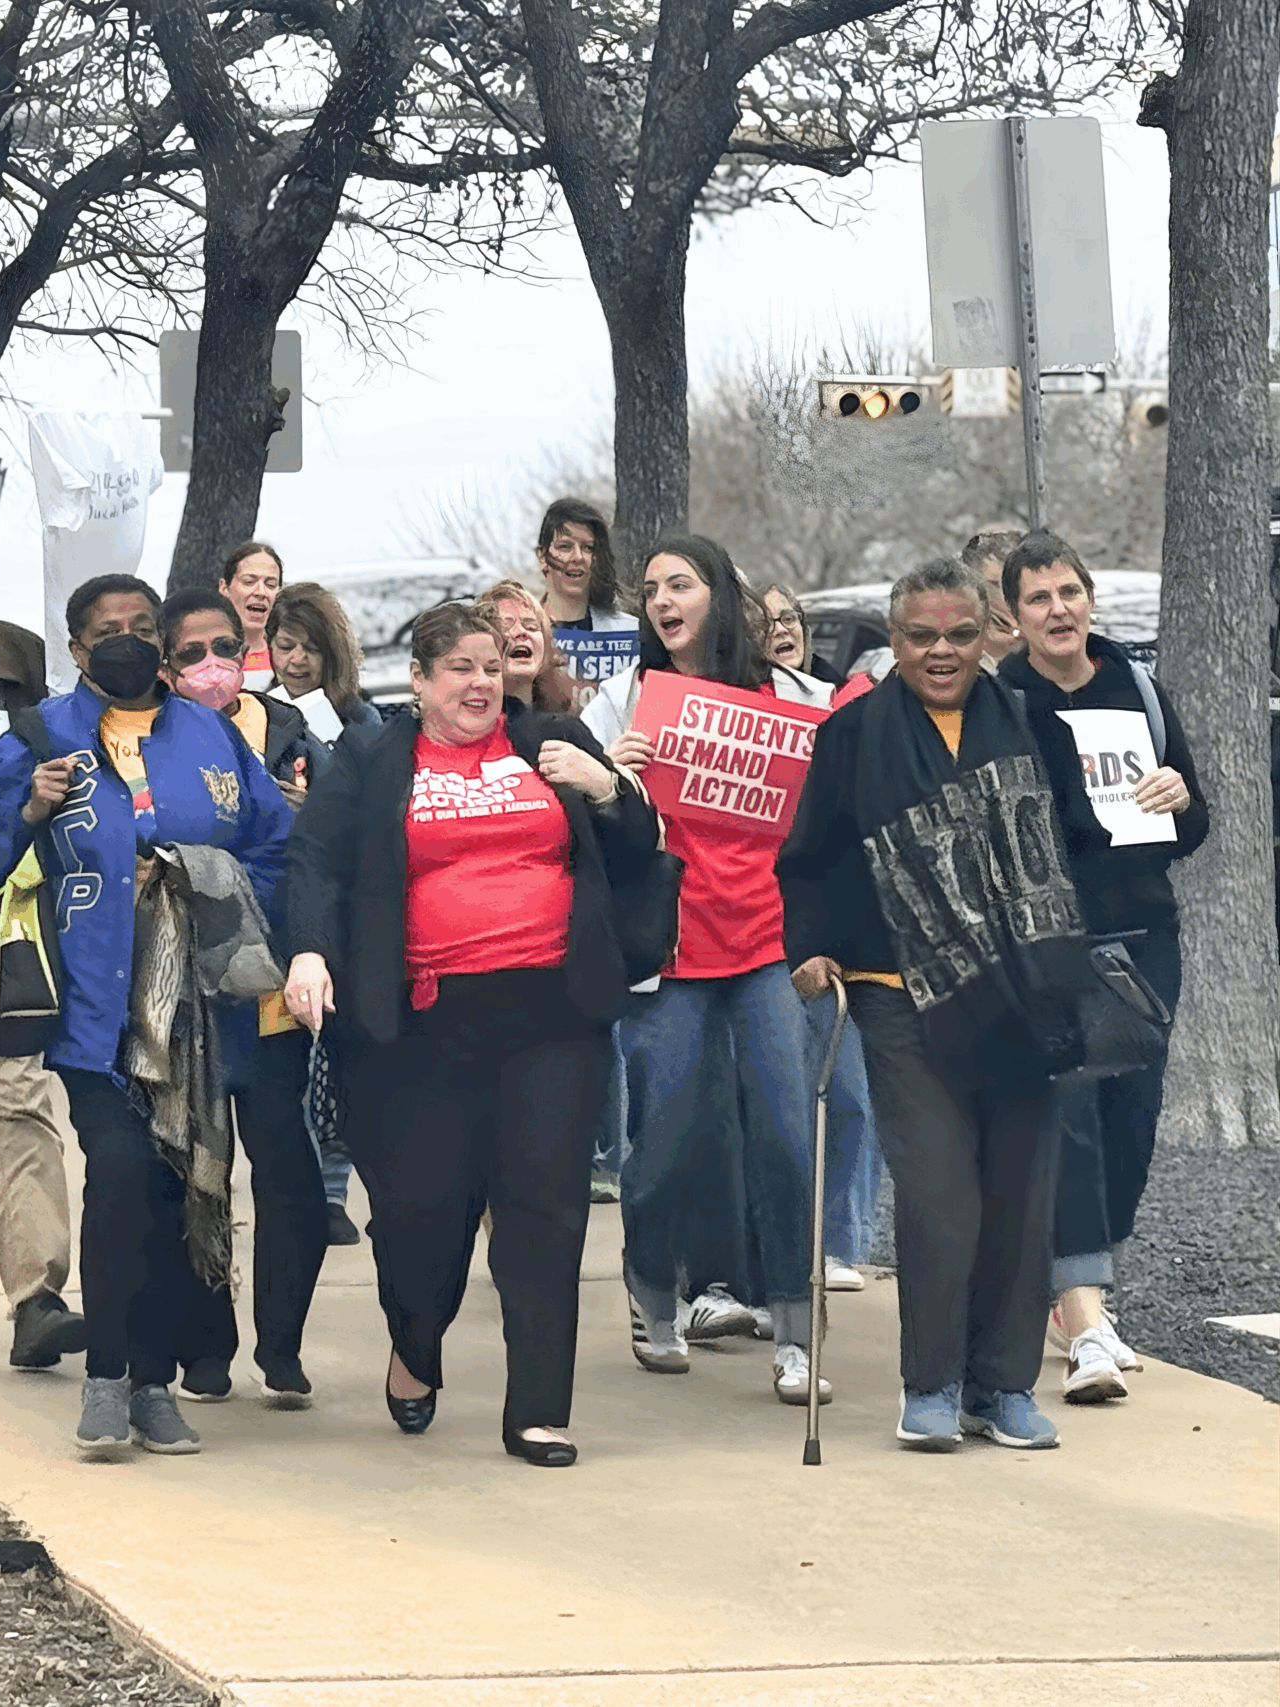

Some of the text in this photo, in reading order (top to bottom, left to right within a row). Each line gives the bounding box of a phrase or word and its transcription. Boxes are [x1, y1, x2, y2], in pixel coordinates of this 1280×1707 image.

[553, 639, 574, 650] WE
[682, 699, 817, 757] STUDENTS
[658, 731, 767, 780] DEMAND
[413, 789, 515, 810] ACTION
[684, 773, 783, 819] ACTION
